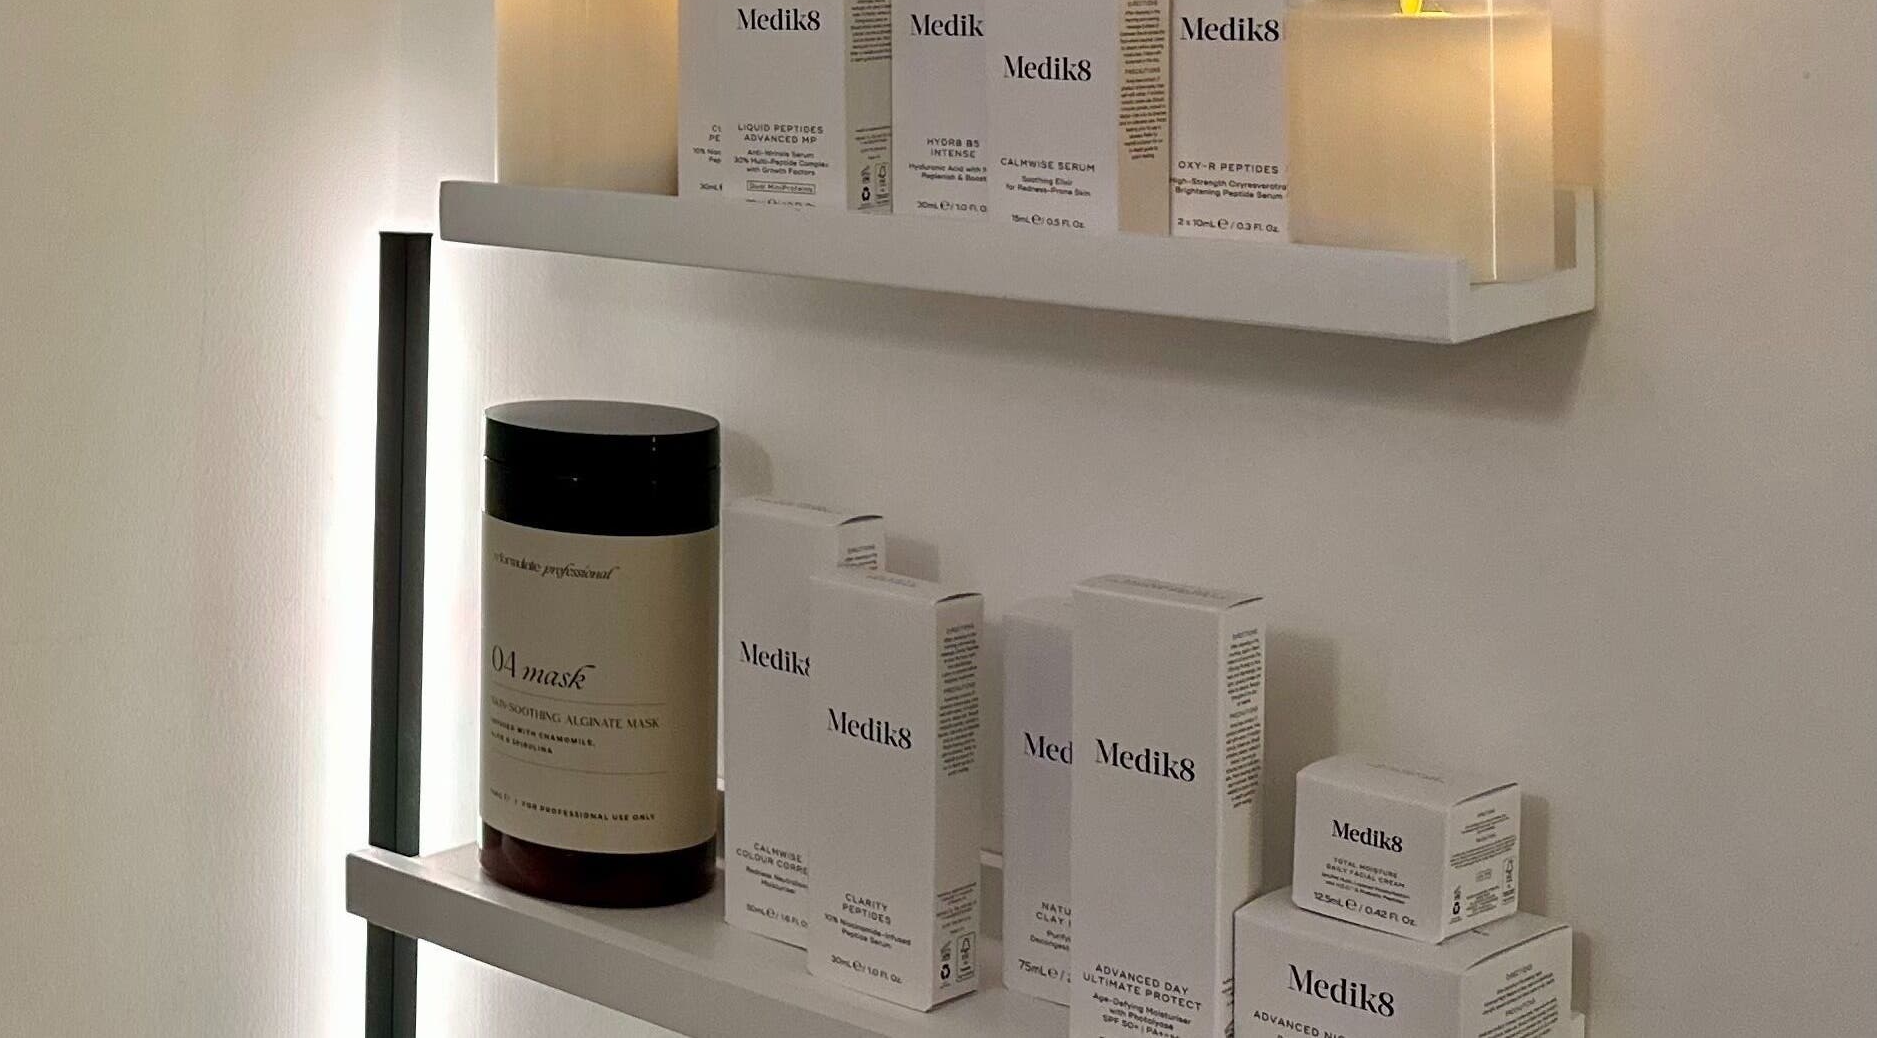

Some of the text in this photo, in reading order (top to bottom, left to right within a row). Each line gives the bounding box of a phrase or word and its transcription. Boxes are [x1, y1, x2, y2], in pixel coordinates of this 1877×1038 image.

[737, 8, 821, 31] Medik8
[910, 13, 985, 37] Medik
[1180, 16, 1280, 42] Medik8
[1003, 54, 1092, 82] Medik8
[737, 123, 824, 135] LIQUID PEPTIDES
[744, 133, 799, 144] ADVANCED
[930, 148, 976, 159] INTENSE
[1000, 157, 1096, 173] CALMWISE SERUM
[1178, 160, 1279, 175] OXY-R PEPTIDES
[1223, 188, 1254, 199] Peptide
[1256, 190, 1283, 200] Serum
[1177, 217, 1184, 226] 2
[1193, 218, 1215, 228] 10mL
[541, 563, 620, 580] professional
[491, 644, 597, 691] 04 mask
[566, 714, 623, 730] ALGINATE
[626, 715, 660, 729] MASK
[827, 707, 913, 751] Medik8
[1023, 731, 1072, 765] Med
[1095, 737, 1196, 783] Medik8
[540, 804, 609, 821] PROFESSIONAL
[612, 814, 630, 822] USE
[632, 813, 656, 822] ONLY
[1331, 819, 1404, 854] Medik8
[736, 848, 809, 876] COLOUR CORRE
[753, 842, 802, 863] CALMWISE
[842, 902, 892, 925] PEPTIDES
[845, 892, 888, 912] CLARITY
[1041, 902, 1072, 916] NATU
[1036, 911, 1065, 925] CLAY
[1095, 963, 1189, 996] ADVANCED DAY
[1287, 962, 1395, 1018] Medik8
[1083, 971, 1202, 1012] ULTIMATE PROTECT
[1253, 1009, 1320, 1037] ADVANCED
